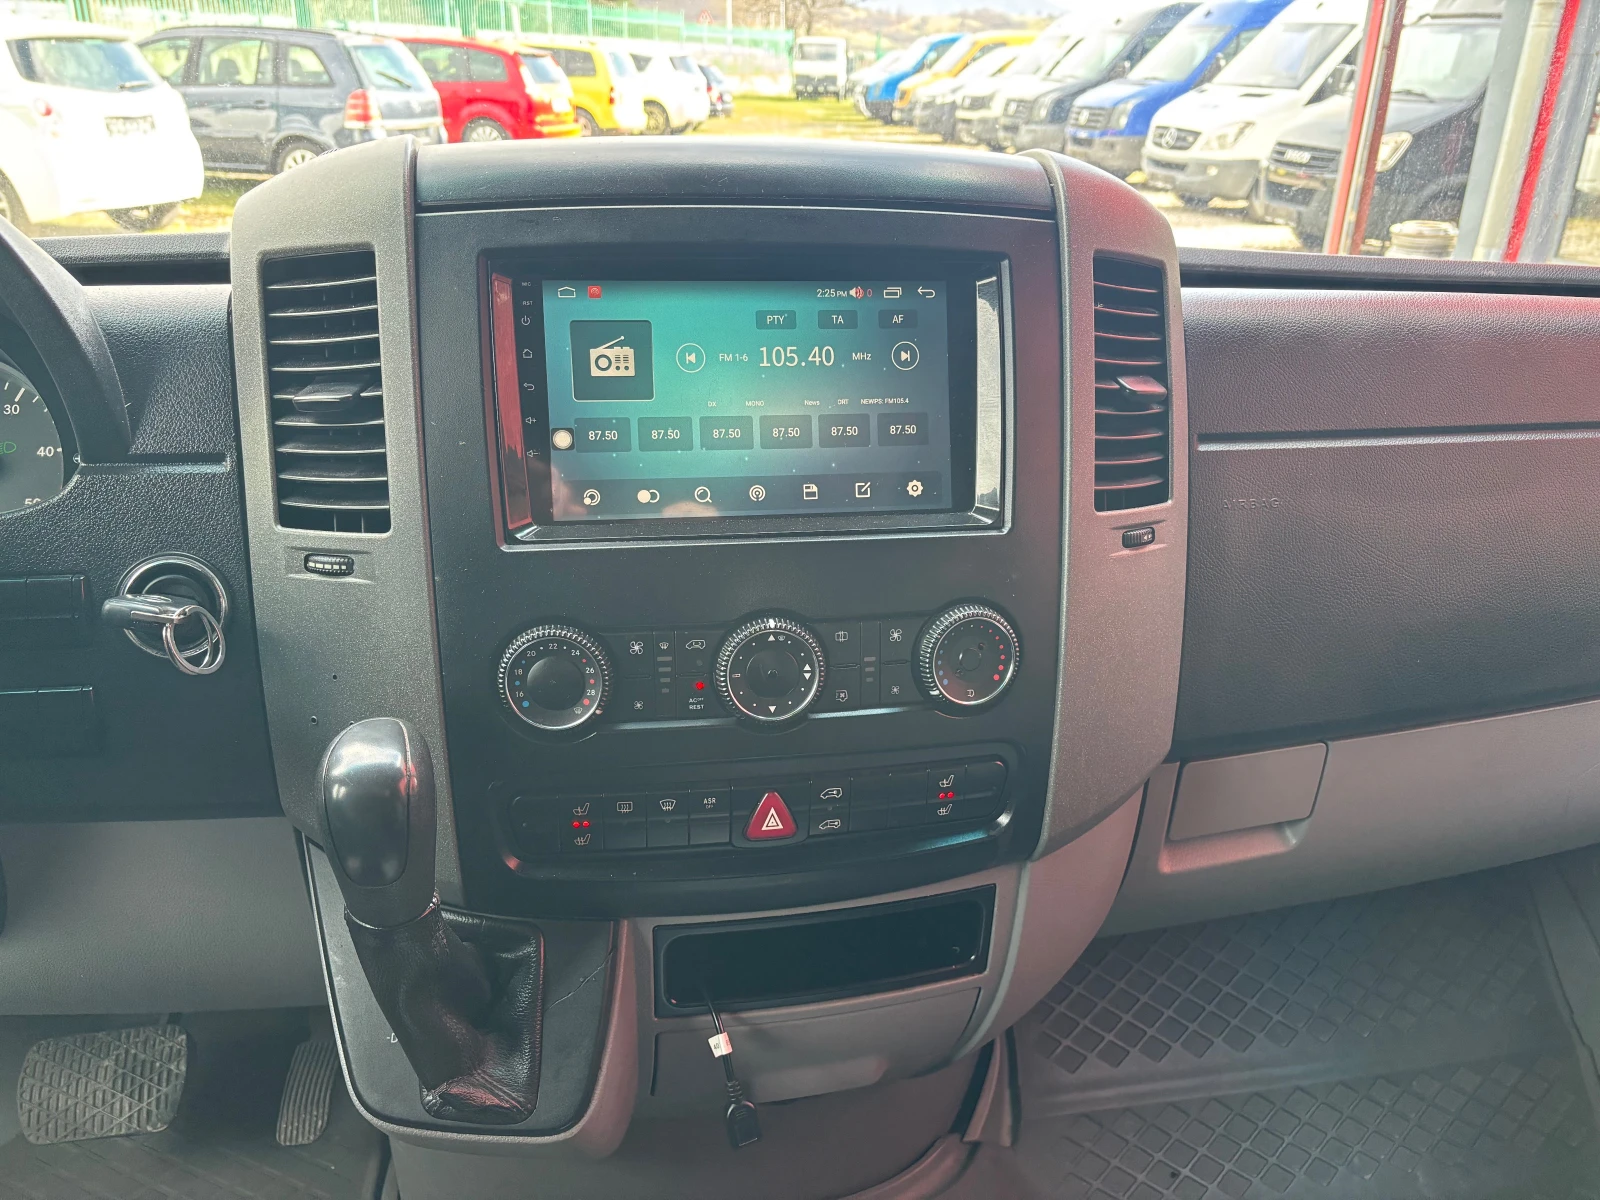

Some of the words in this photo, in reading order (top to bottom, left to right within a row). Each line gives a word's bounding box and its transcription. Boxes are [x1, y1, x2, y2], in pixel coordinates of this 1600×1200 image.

[817, 289, 836, 298] 2:25
[766, 315, 785, 325] PTY
[831, 315, 844, 324] TA
[892, 315, 904, 324] AF
[719, 353, 733, 362] FM
[735, 353, 749, 362] 1-6
[759, 345, 835, 367] 105.40
[852, 352, 872, 361] MHz
[3, 404, 20, 415] 30
[651, 429, 680, 440] 87.50
[712, 428, 741, 439] 87.50
[772, 427, 800, 438] 87.50
[831, 426, 859, 436] 87.50
[889, 425, 917, 435] 87.50
[588, 430, 618, 441] 87.50
[36, 446, 55, 457] 40
[514, 668, 523, 676] 18
